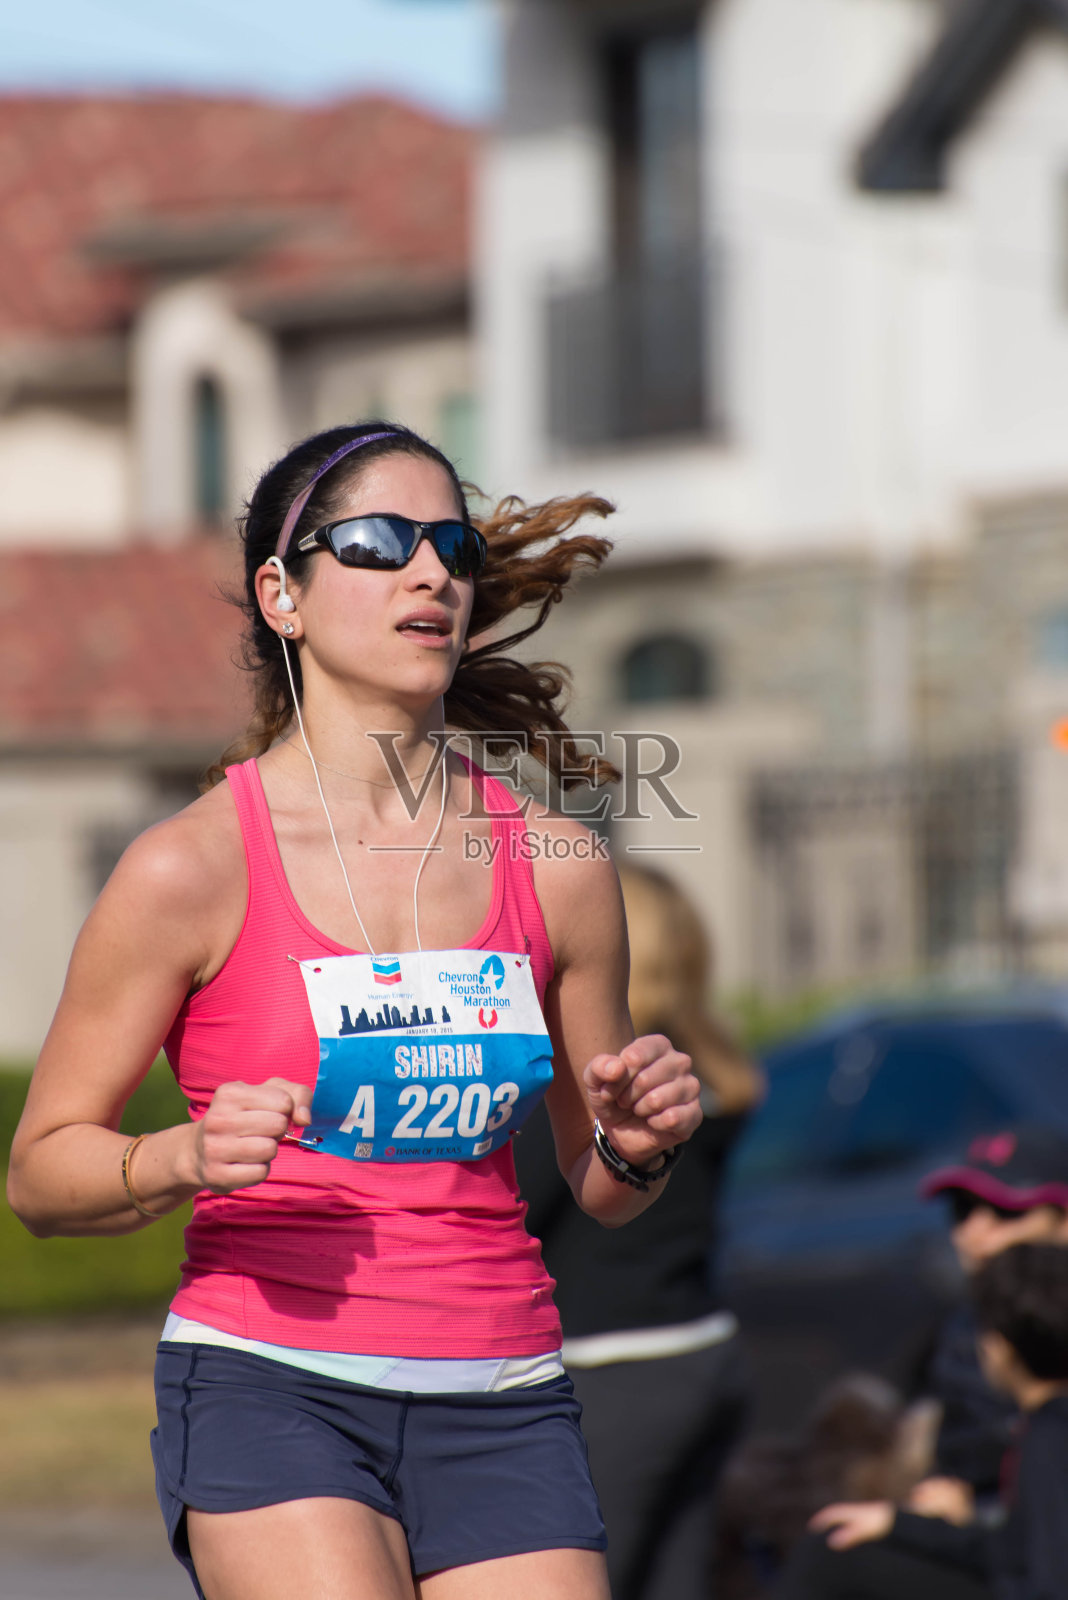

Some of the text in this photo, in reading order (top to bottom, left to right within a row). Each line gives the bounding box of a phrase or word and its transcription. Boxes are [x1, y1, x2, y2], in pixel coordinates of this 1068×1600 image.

[438, 971, 479, 983] Chevron
[450, 983, 492, 995] Houston
[463, 995, 511, 1007] Marathon
[394, 1043, 483, 1079] SHIRIN
[338, 1081, 520, 1138] A 2203
[396, 1148, 420, 1156] BANK
[436, 1147, 462, 1155] TEXAS
